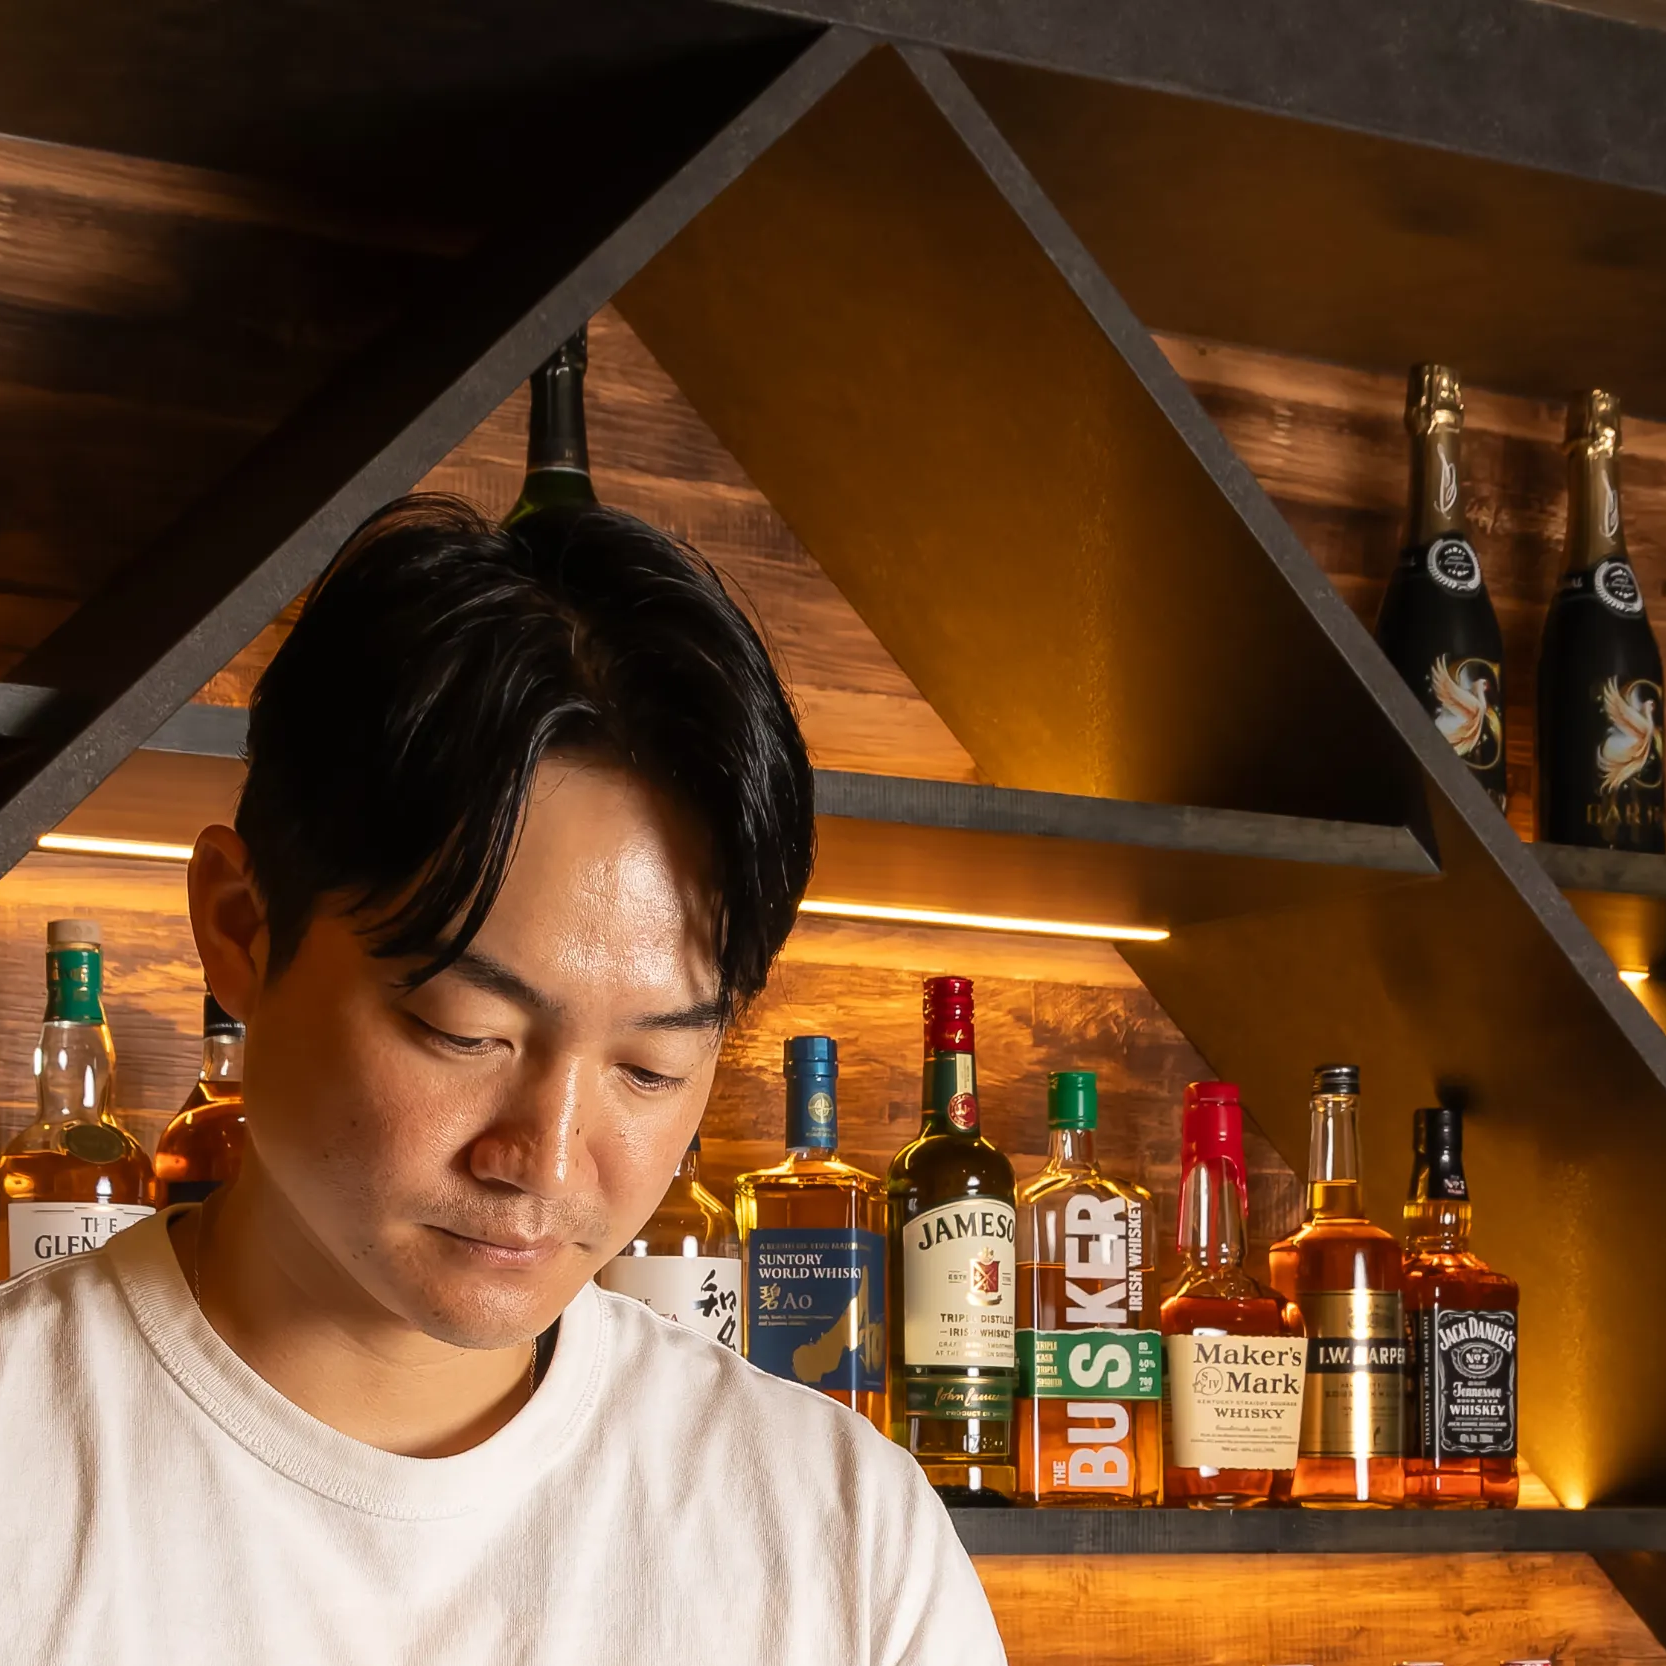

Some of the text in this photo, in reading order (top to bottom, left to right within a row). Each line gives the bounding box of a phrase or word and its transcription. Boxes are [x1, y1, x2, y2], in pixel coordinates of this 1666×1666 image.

[918, 1212, 1015, 1250] JAMESO
[758, 1254, 823, 1266] SUNTORY
[1128, 1200, 1144, 1312] IRISH WHISKEY
[758, 1267, 810, 1279] WORLD
[1052, 1193, 1132, 1488] THE BUSKER
[1438, 1316, 1516, 1353] JACK DANIEL'S
[1193, 1342, 1302, 1367] Maker's
[1225, 1371, 1300, 1395] Mark
[1214, 1407, 1285, 1419] WHISKY
[1449, 1404, 1506, 1416] WHISKEY
